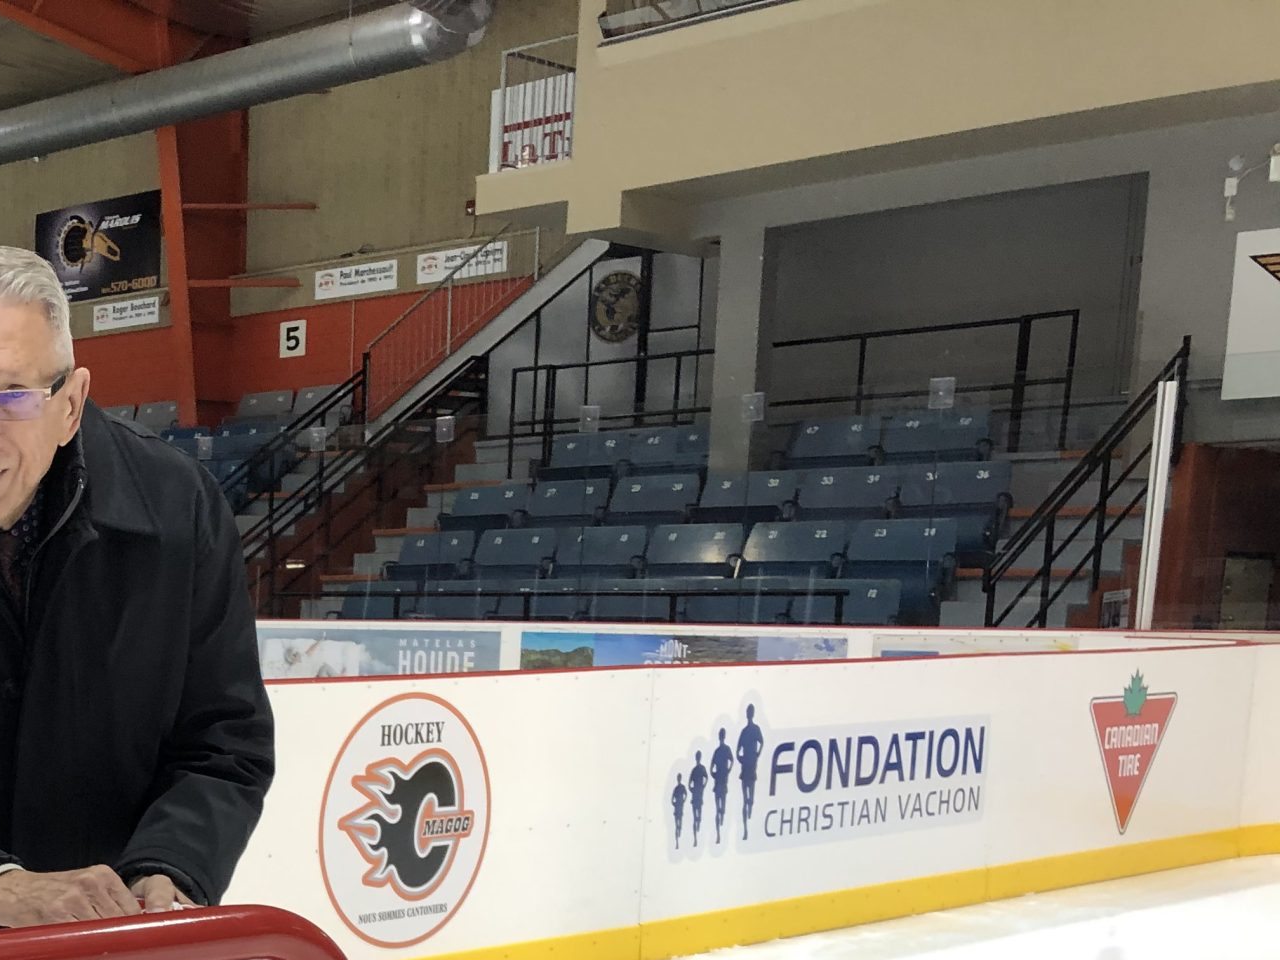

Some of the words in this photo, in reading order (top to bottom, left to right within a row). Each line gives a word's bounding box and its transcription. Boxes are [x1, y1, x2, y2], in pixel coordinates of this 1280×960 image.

[285, 326, 300, 351] 5
[399, 638, 476, 648] MATELAS
[398, 650, 475, 675] HOUDE
[380, 721, 445, 747] HOCKEY
[1104, 723, 1159, 750] CANADIAN
[768, 726, 986, 797] FONDATION
[1118, 753, 1141, 777] TIRE
[764, 796, 888, 838] CHRISTIAN
[897, 785, 981, 820] VACHON
[422, 815, 470, 837] MAGOG
[358, 911, 377, 925] NOUS
[377, 908, 406, 922] SOMMES
[406, 903, 448, 918] CANTONIERS
